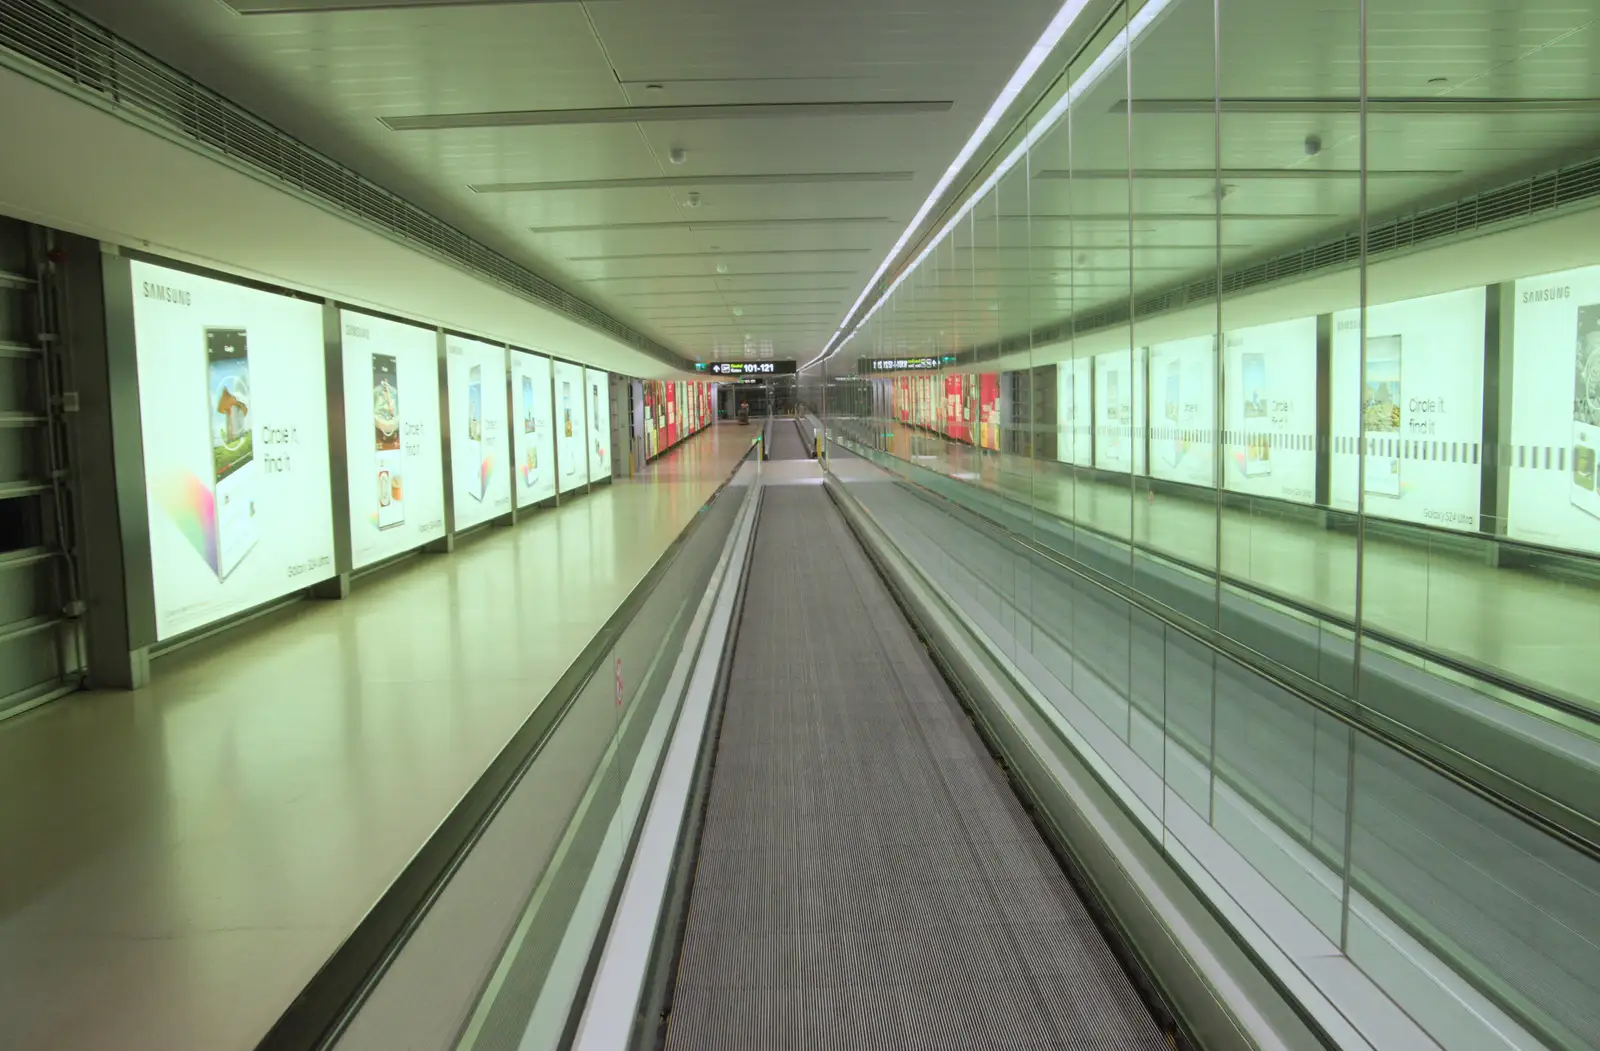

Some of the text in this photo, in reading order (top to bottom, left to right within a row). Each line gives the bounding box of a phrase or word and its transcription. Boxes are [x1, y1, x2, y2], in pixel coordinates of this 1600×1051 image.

[143, 281, 191, 306] SAMSUNG
[1523, 286, 1571, 303] SAMSUNG
[744, 364, 774, 372] 101-121
[1409, 396, 1436, 413] Circle
[262, 424, 289, 444] Circle
[1409, 418, 1427, 435] find
[264, 453, 282, 473] find
